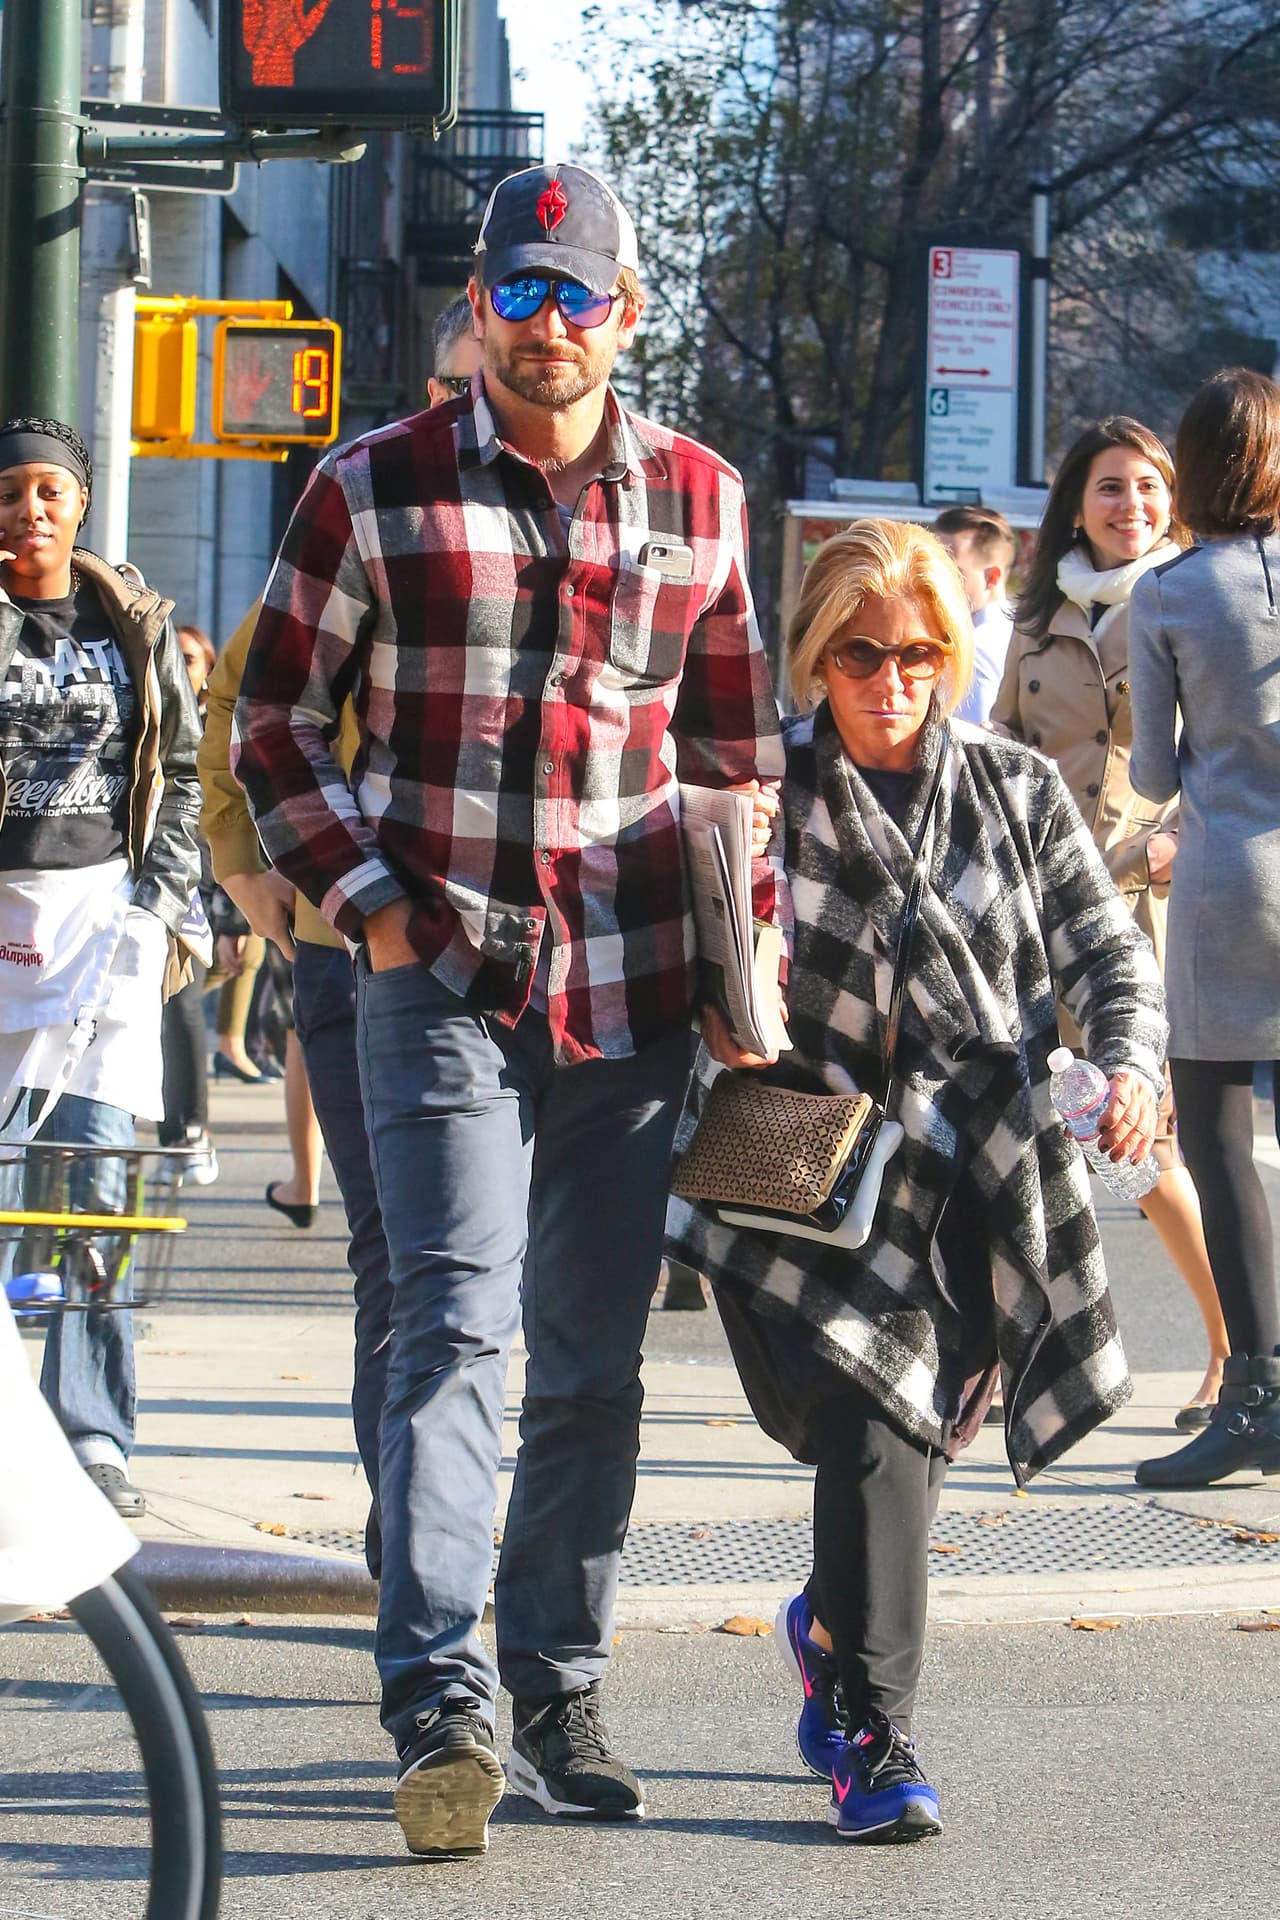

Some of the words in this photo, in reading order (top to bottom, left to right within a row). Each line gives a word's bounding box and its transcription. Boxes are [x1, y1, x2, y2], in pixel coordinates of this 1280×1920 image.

[935, 252, 951, 277] 3
[293, 348, 329, 417] 19
[932, 389, 947, 415] 6
[5, 809, 32, 818] ANTA
